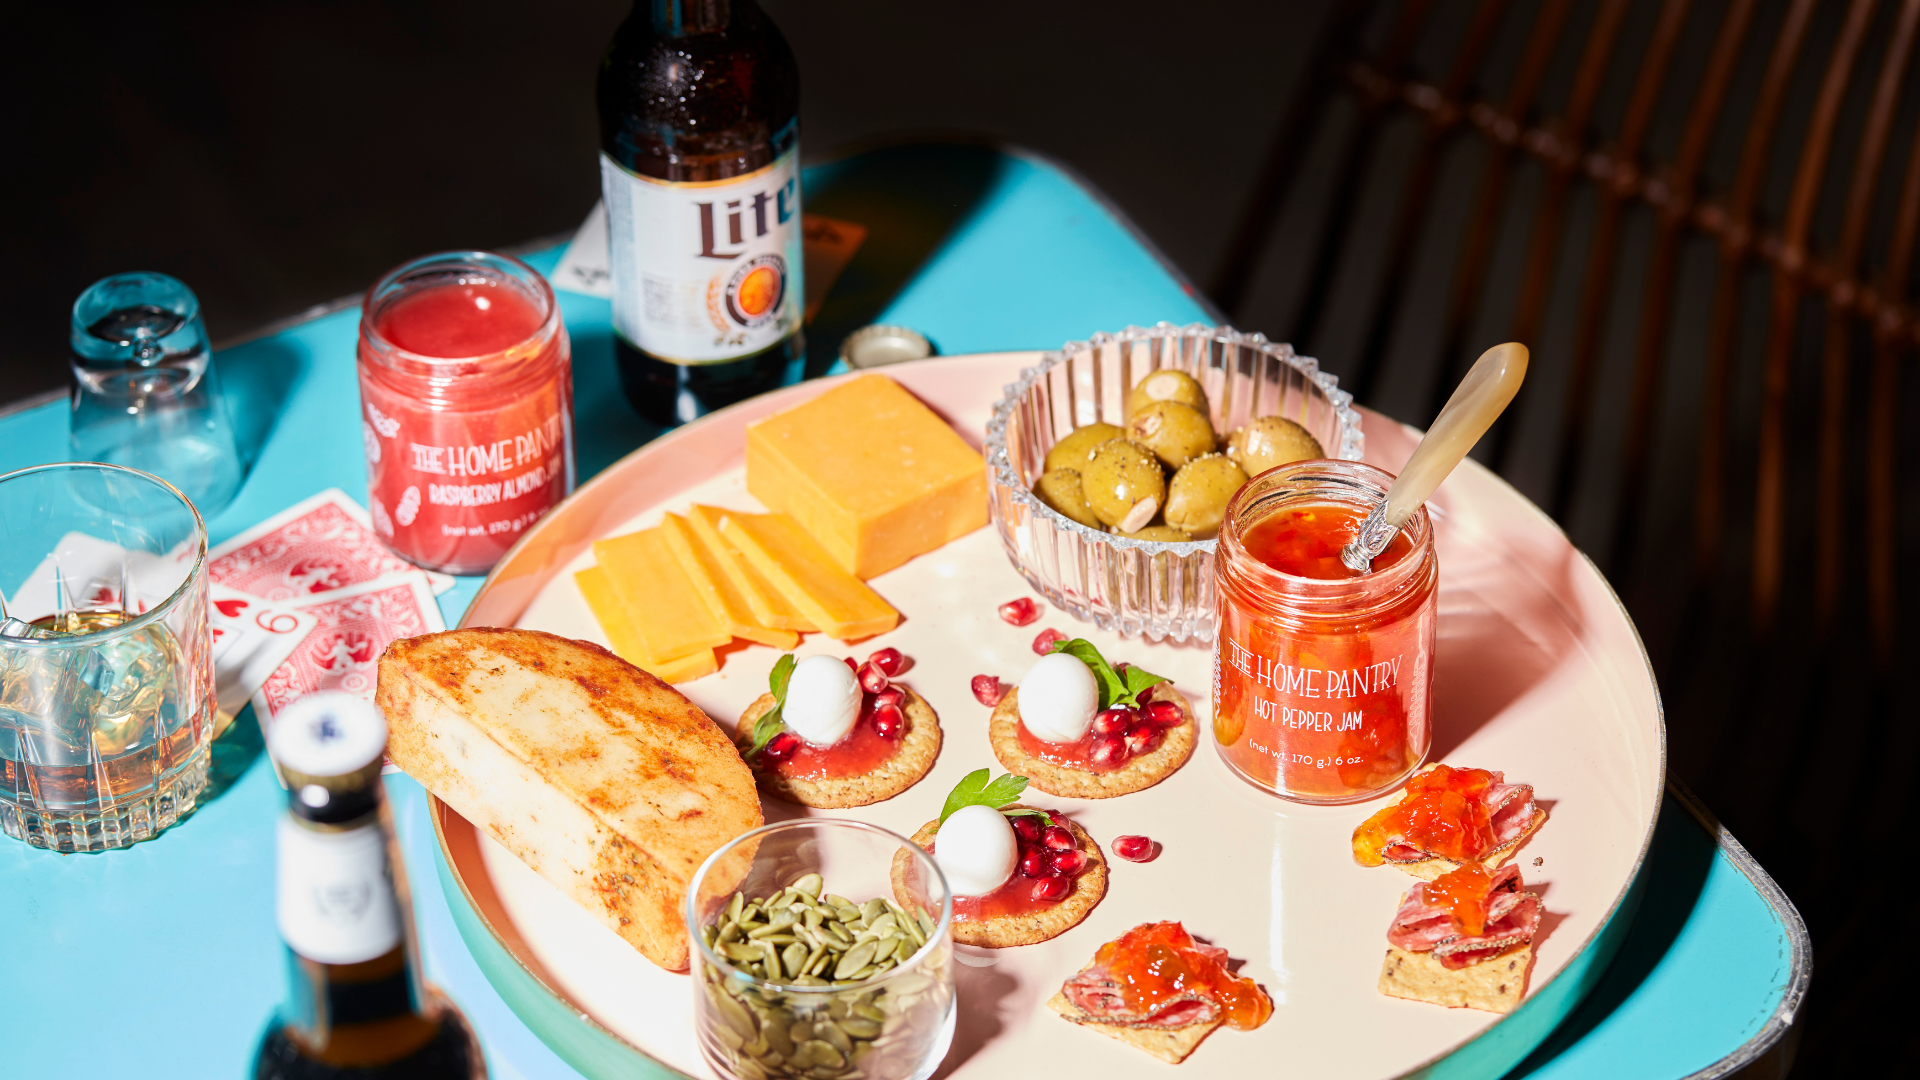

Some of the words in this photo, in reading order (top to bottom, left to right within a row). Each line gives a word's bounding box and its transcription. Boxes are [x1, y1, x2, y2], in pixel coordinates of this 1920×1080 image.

[691, 177, 795, 259] Lite
[411, 445, 444, 473] THE
[448, 439, 513, 476] HOME
[428, 483, 501, 507] RASPBERRY
[502, 465, 546, 501] ALMOND
[1229, 639, 1253, 676] THE
[1257, 655, 1321, 698] HOME
[1325, 654, 1403, 699] PANTRY
[1254, 695, 1277, 723] HOT
[1282, 706, 1333, 732] PEPPER
[1336, 710, 1363, 732] JAM
[1249, 738, 1269, 755] (net
[1271, 750, 1288, 761] wt.
[1292, 753, 1313, 765] 170
[1316, 756, 1331, 769] g.)
[1335, 756, 1344, 766] 6
[1346, 756, 1364, 765] oz.
